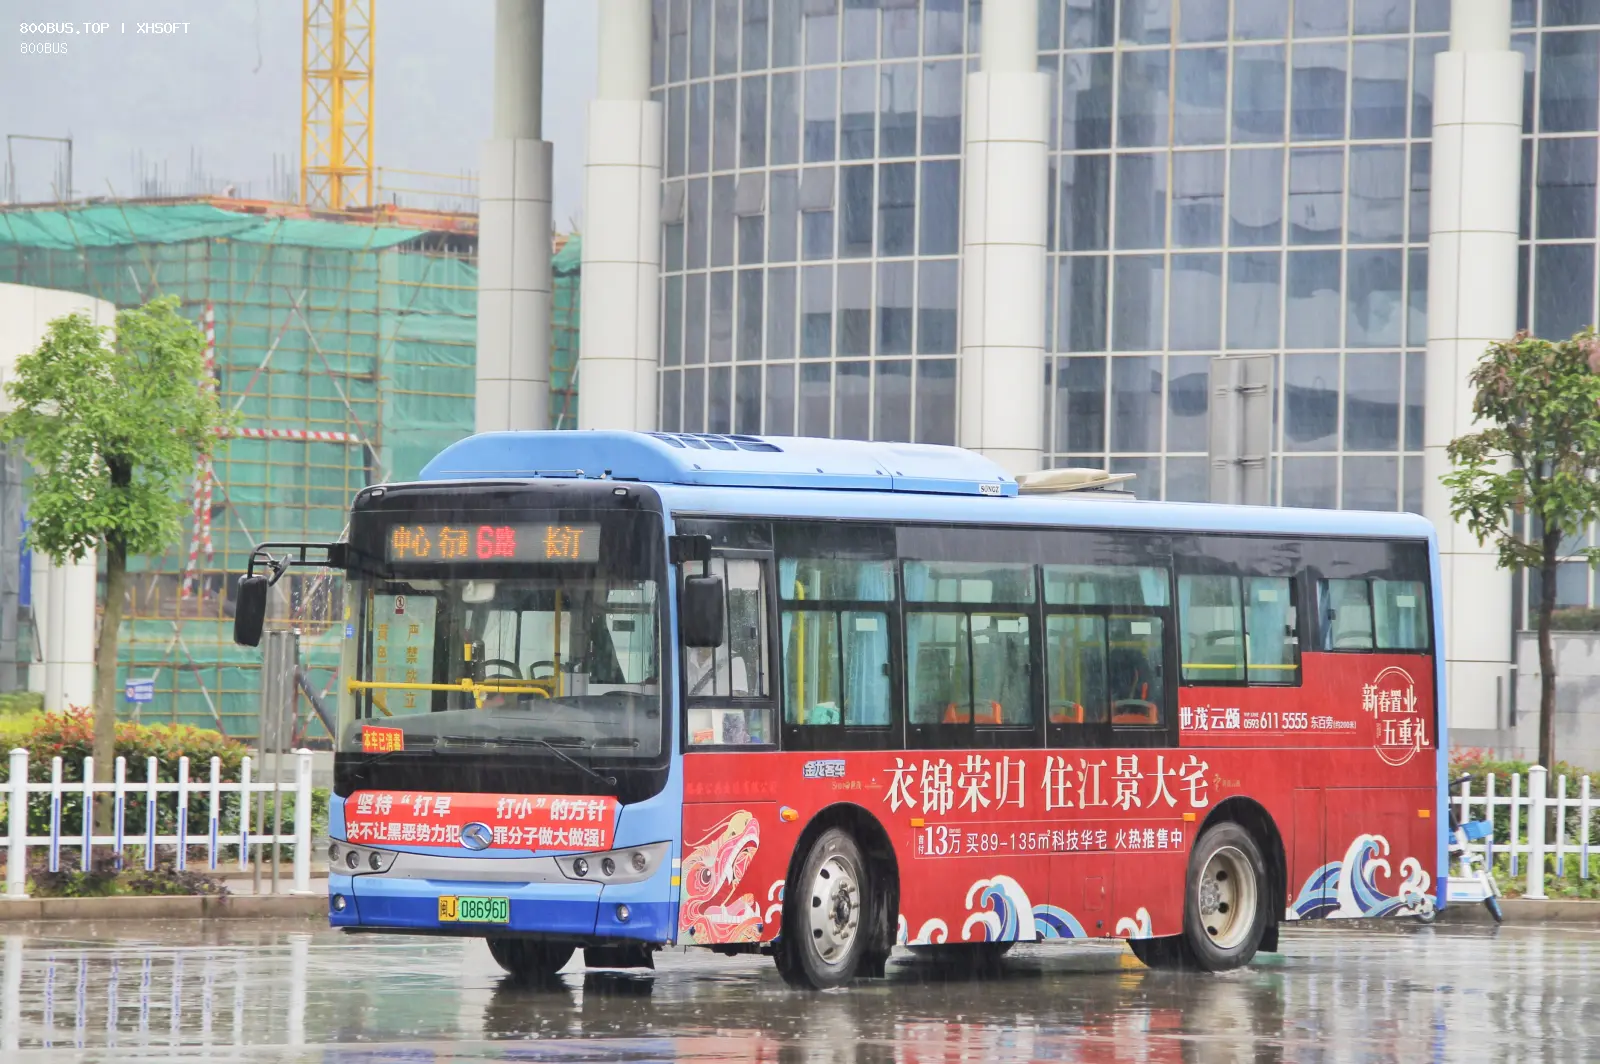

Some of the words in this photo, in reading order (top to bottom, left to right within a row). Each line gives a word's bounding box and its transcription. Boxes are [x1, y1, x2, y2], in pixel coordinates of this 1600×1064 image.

[1362, 683, 1418, 719] 新春置业
[1179, 706, 1240, 730] 世茂云颂
[1282, 713, 1307, 729] 5555
[1382, 718, 1430, 752] 五重礼
[804, 762, 845, 778] 金龙客车
[883, 754, 1026, 815] 衣锦荣归
[1041, 754, 1209, 811] 住江景大宅
[346, 821, 460, 843] 决不让黑恶势力犯
[1114, 828, 1183, 849] 火热推售中
[461, 900, 507, 919] 08696D
